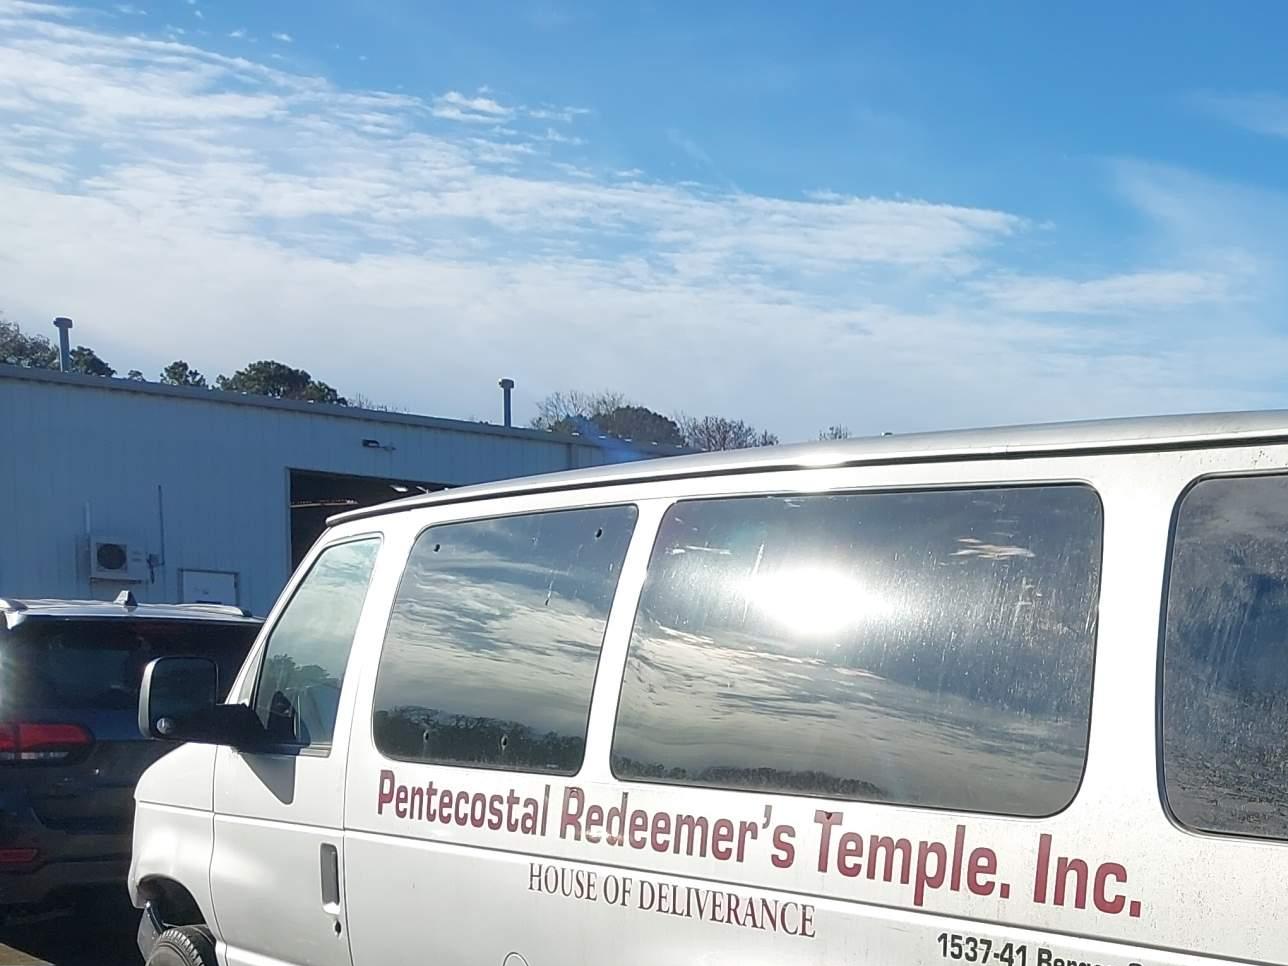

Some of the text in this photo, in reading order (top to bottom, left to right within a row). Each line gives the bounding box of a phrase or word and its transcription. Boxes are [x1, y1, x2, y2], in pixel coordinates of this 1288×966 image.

[378, 769, 1142, 918] Pentecostal Redeemer's Temple. Inc.
[528, 863, 816, 938] HOUSE OF DELIVERANCE
